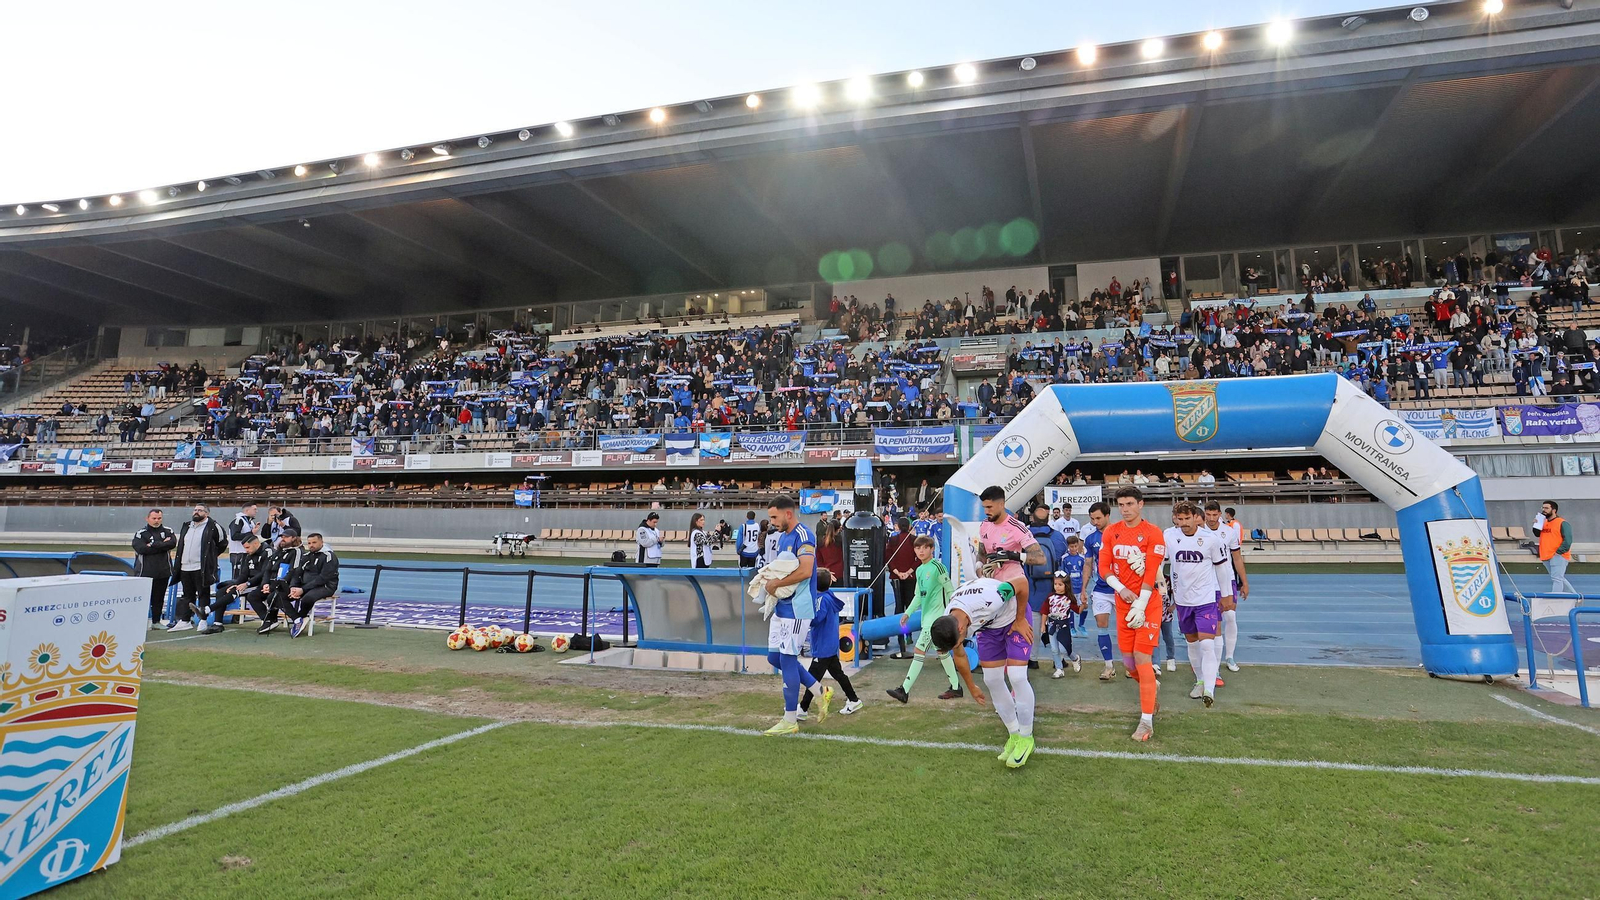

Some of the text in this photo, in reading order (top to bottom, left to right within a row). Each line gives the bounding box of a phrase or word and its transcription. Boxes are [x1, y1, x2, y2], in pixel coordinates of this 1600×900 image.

[1406, 410, 1487, 419] YOU'LL NEVER
[1525, 419, 1548, 427] Rafa
[1549, 418, 1577, 426] Verdú
[739, 434, 788, 443] XERECISMO
[1418, 429, 1490, 438] RINK ALONE
[879, 435, 950, 445] LA PENÚLTIMA XCD
[624, 454, 656, 465] JEREZ
[809, 449, 868, 461] PLAY JEREZ
[1344, 431, 1410, 481] MOVITRANSA
[1003, 446, 1055, 493] MOVITRANSA
[1058, 495, 1100, 503] JEREZ2031
[747, 529, 758, 542] 15
[1461, 565, 1490, 605] XEREZ
[964, 587, 984, 595] JAVI
